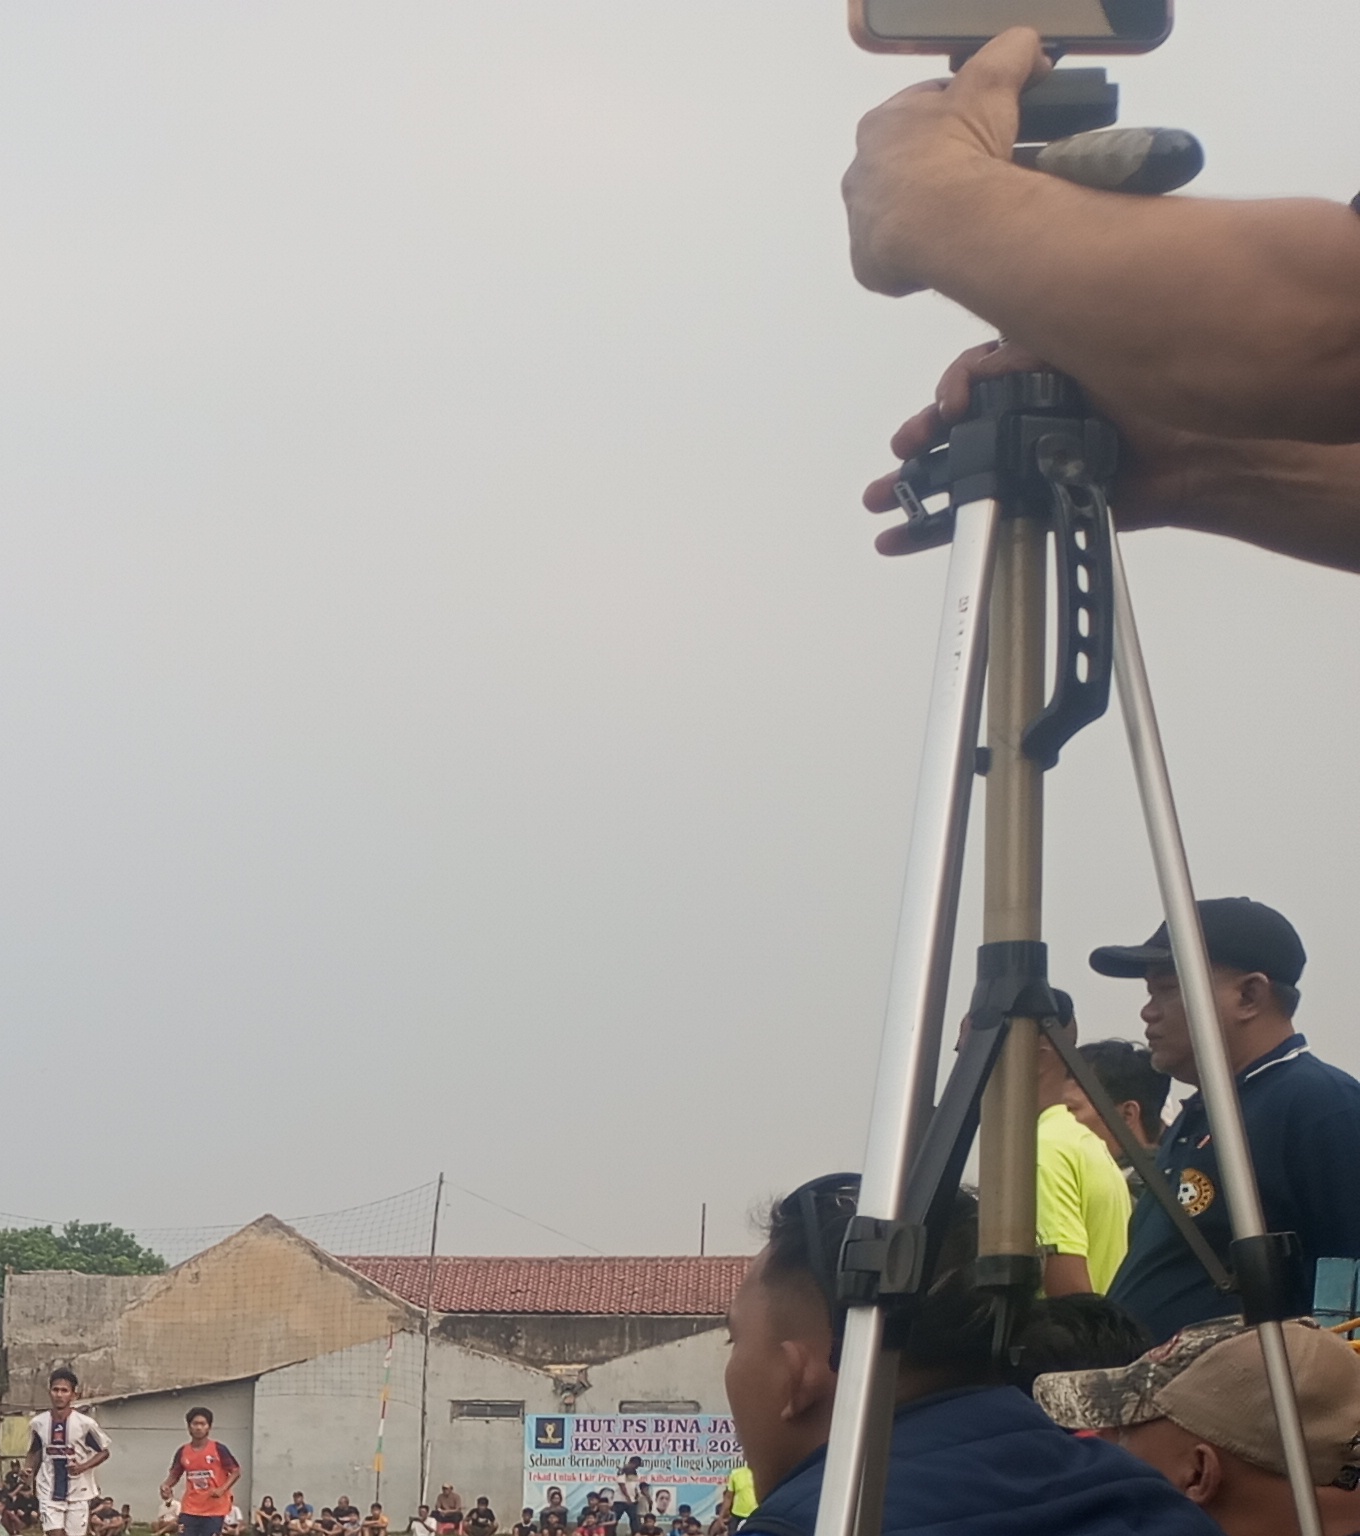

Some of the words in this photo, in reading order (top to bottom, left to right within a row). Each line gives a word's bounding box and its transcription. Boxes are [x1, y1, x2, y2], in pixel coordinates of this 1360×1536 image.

[575, 1419, 616, 1433] HUT
[622, 1419, 646, 1433] PS
[654, 1419, 702, 1434] BINA
[707, 1419, 735, 1434] JA
[573, 1438, 601, 1452] KE
[607, 1438, 662, 1452] XXVII
[668, 1439, 701, 1453] TH.
[529, 1453, 566, 1468] Selamat
[568, 1454, 622, 1470] Bertanding
[673, 1455, 704, 1471] Tinggi
